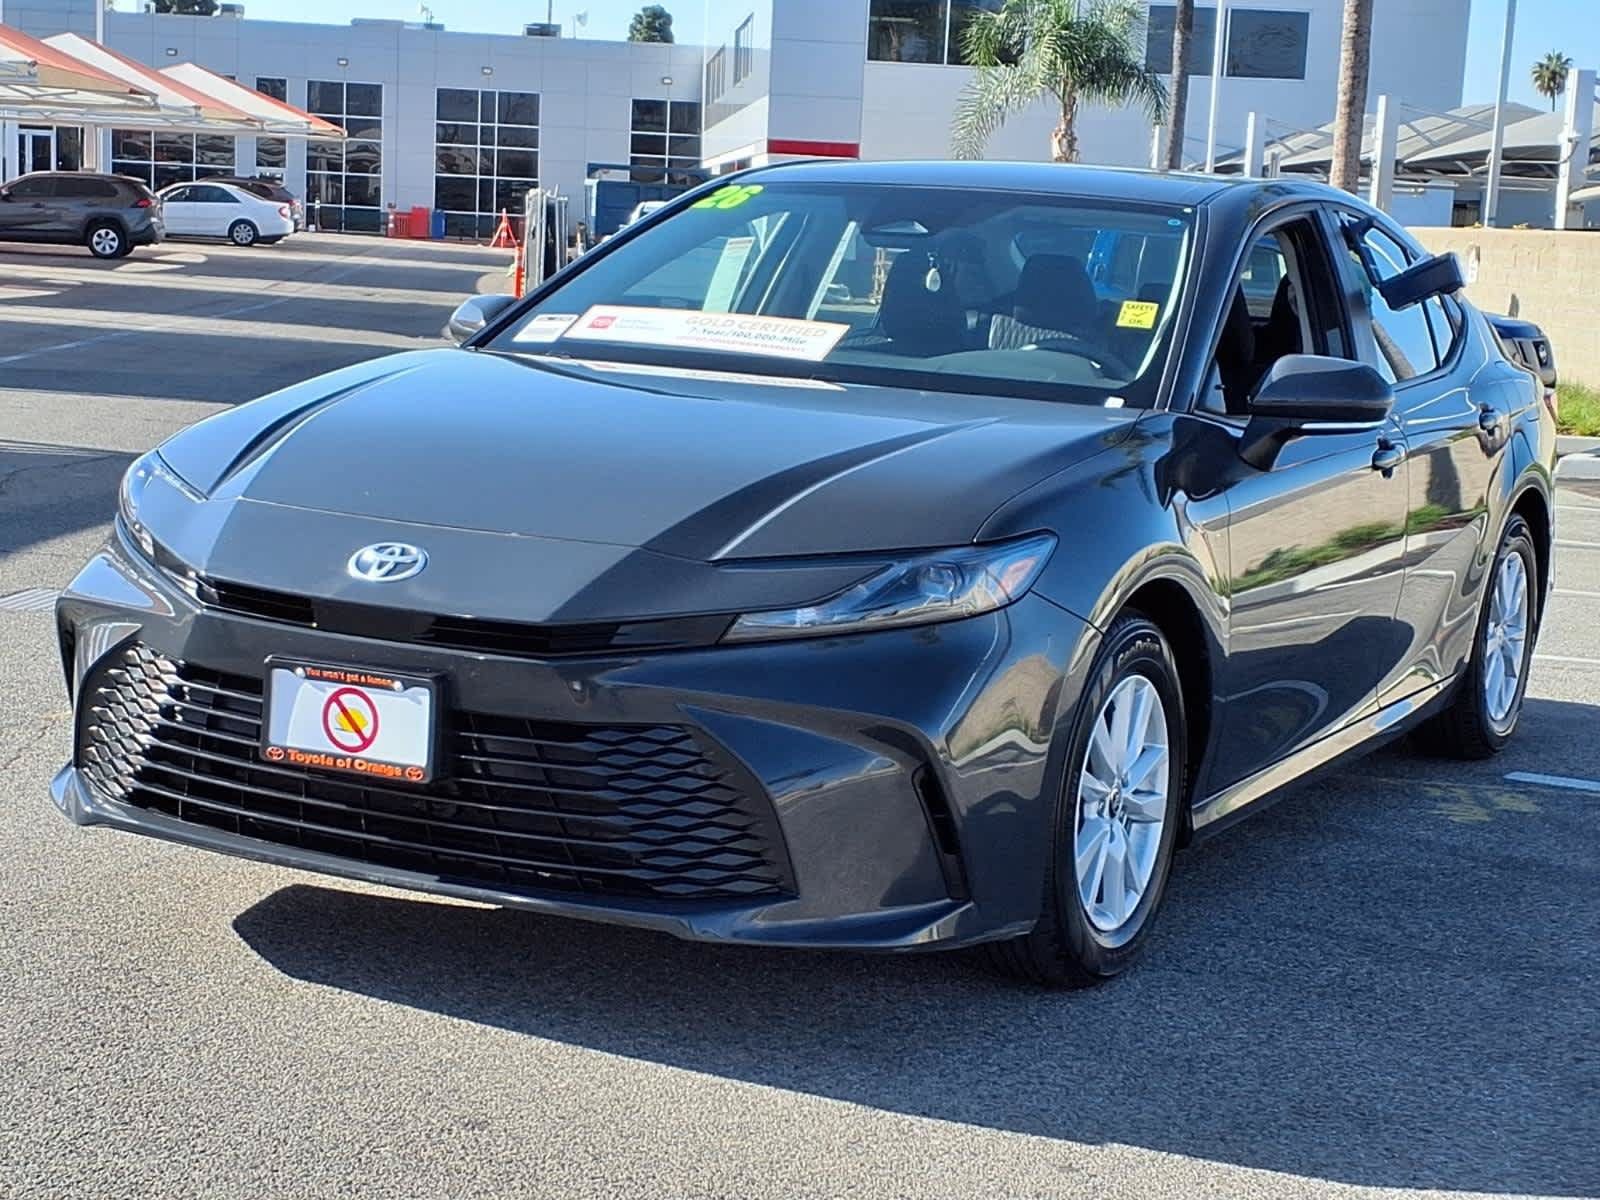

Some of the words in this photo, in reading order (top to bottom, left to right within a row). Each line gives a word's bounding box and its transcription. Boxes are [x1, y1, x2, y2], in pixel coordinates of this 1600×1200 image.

[692, 185, 764, 209] 26
[1126, 303, 1154, 312] SAFETY
[685, 316, 736, 328] GOLD
[738, 318, 827, 337] CERTIFIED
[287, 749, 334, 767] Toyota
[336, 757, 351, 769] of
[353, 758, 402, 778] Orange
